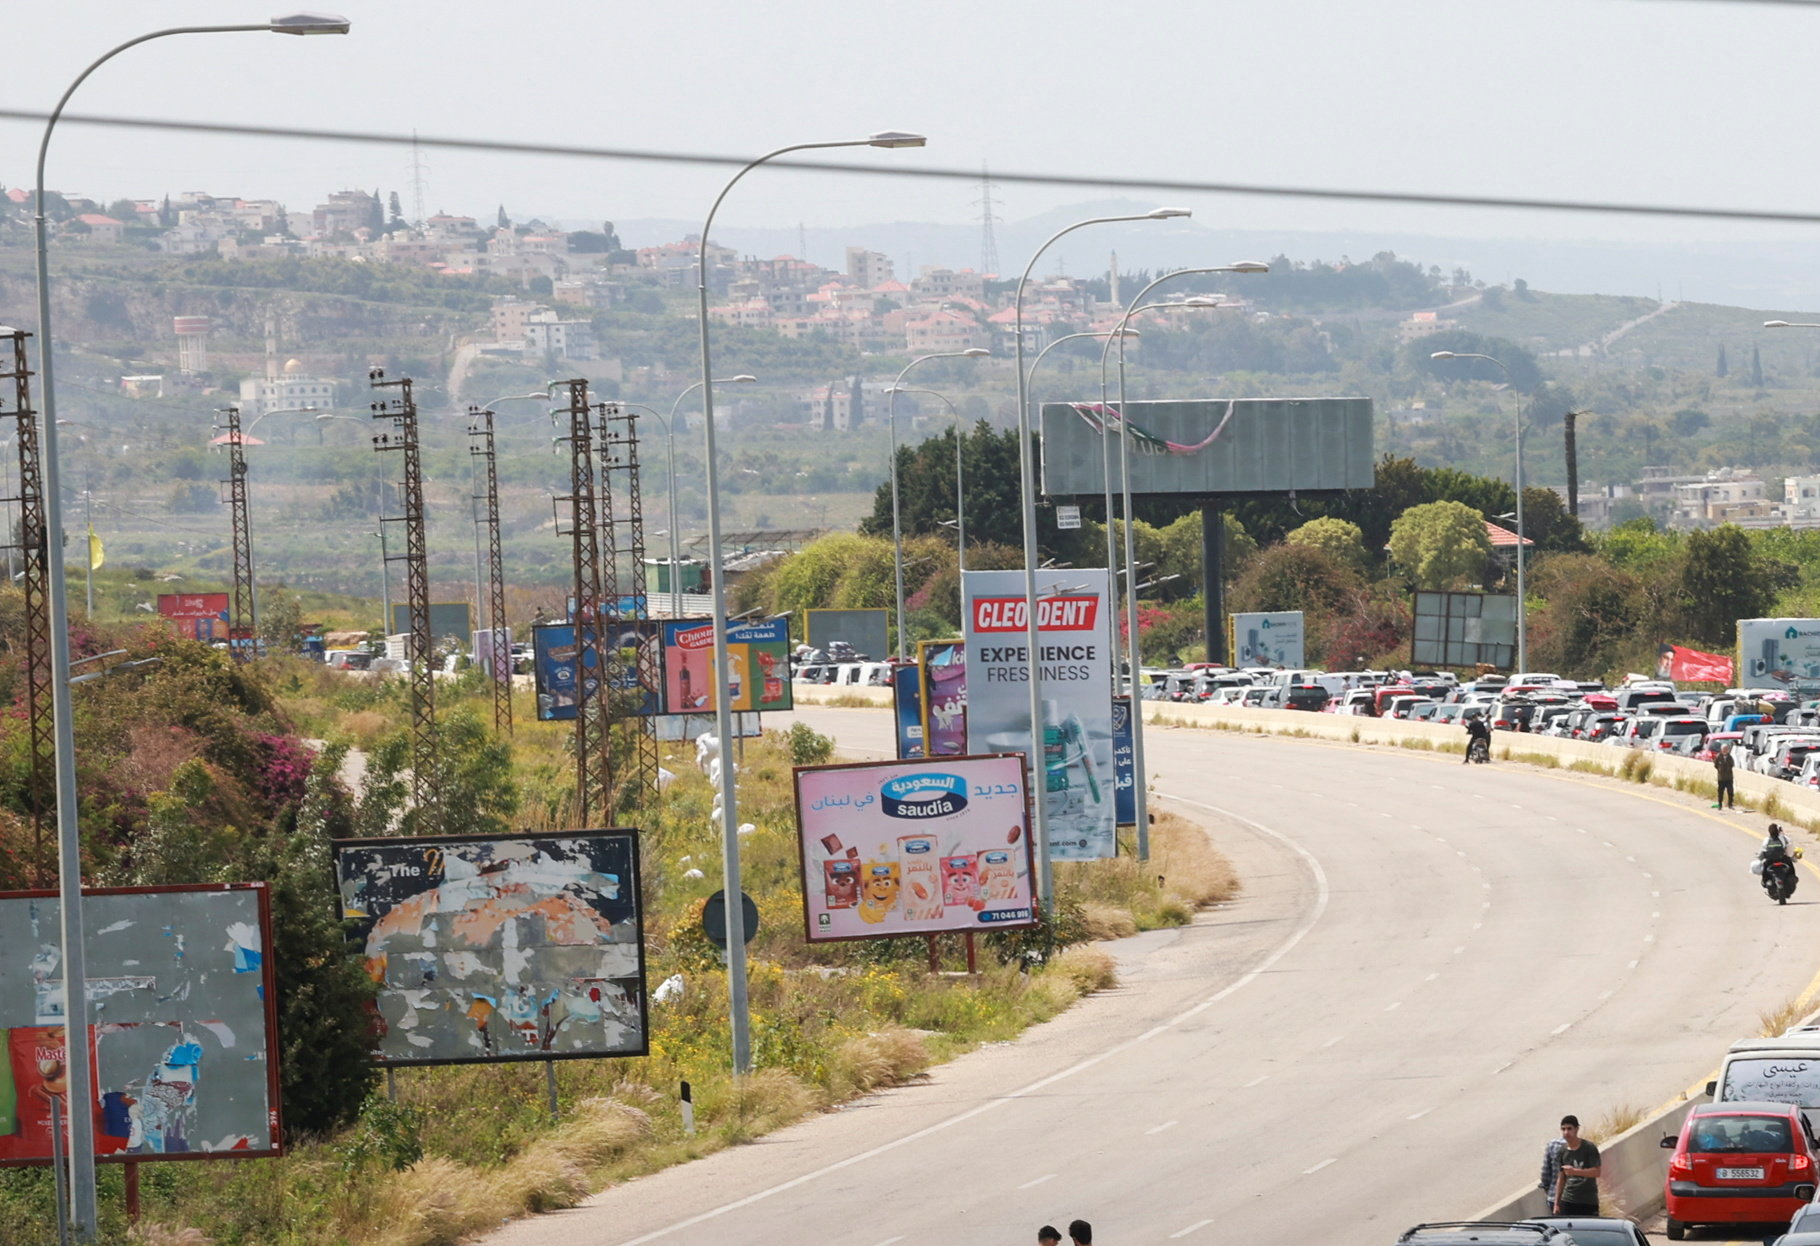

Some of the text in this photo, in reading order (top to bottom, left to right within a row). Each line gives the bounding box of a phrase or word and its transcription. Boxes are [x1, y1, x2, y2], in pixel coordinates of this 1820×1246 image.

[981, 646, 1096, 662] EXPEIENCE
[988, 665, 1090, 682] FRESNESS
[891, 775, 955, 793] السعودية
[810, 783, 1018, 812] جديد في لبنان
[897, 799, 953, 817] saudia
[389, 865, 421, 878] The
[1763, 1062, 1808, 1079] عيسى
